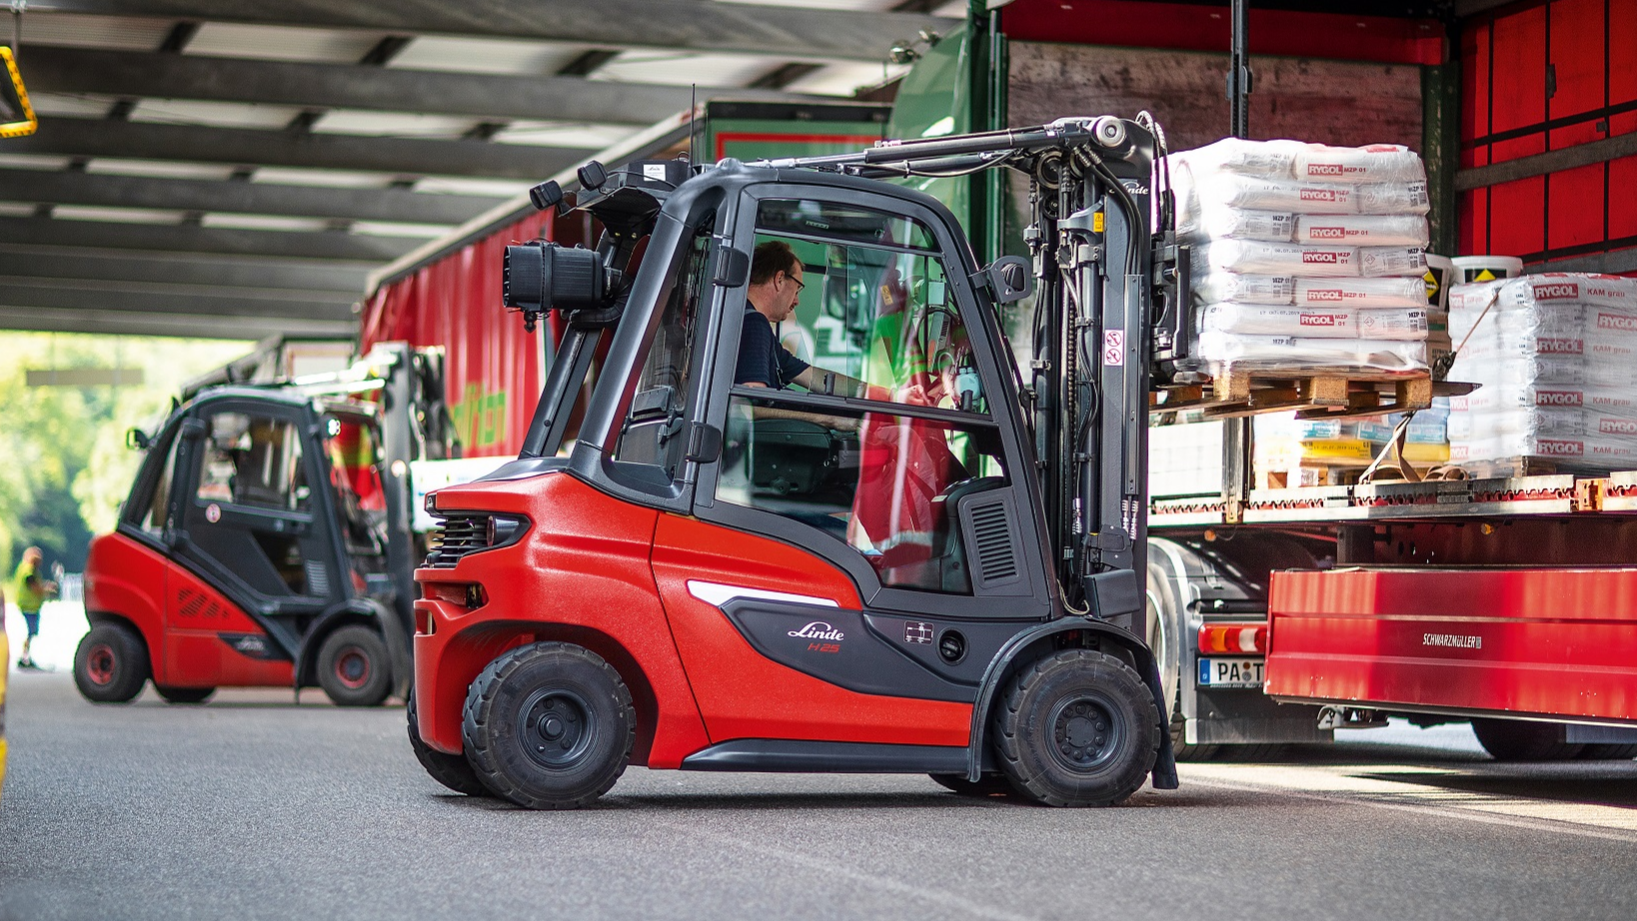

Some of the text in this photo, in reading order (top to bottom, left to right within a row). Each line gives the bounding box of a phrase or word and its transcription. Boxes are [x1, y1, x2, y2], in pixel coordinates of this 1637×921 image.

[1308, 165, 1342, 175] RYGOL
[1301, 190, 1335, 199] RYGOL
[1310, 228, 1344, 238] RYGOL
[1303, 254, 1336, 262] RYGOL
[1308, 291, 1342, 300] RYGOL
[1535, 285, 1577, 298] RYGOL
[1587, 288, 1605, 296] KAM
[1300, 316, 1334, 324] RYGOL
[1600, 315, 1637, 328] RYGO
[1538, 340, 1582, 352] RYGOL
[1538, 393, 1630, 406] RYGOL KAM grau
[1538, 442, 1631, 455] RYGOL KAM grau
[787, 621, 844, 641] Linde
[1422, 633, 1476, 649] SCHWARZMÜLLER
[1217, 662, 1240, 681] PA
